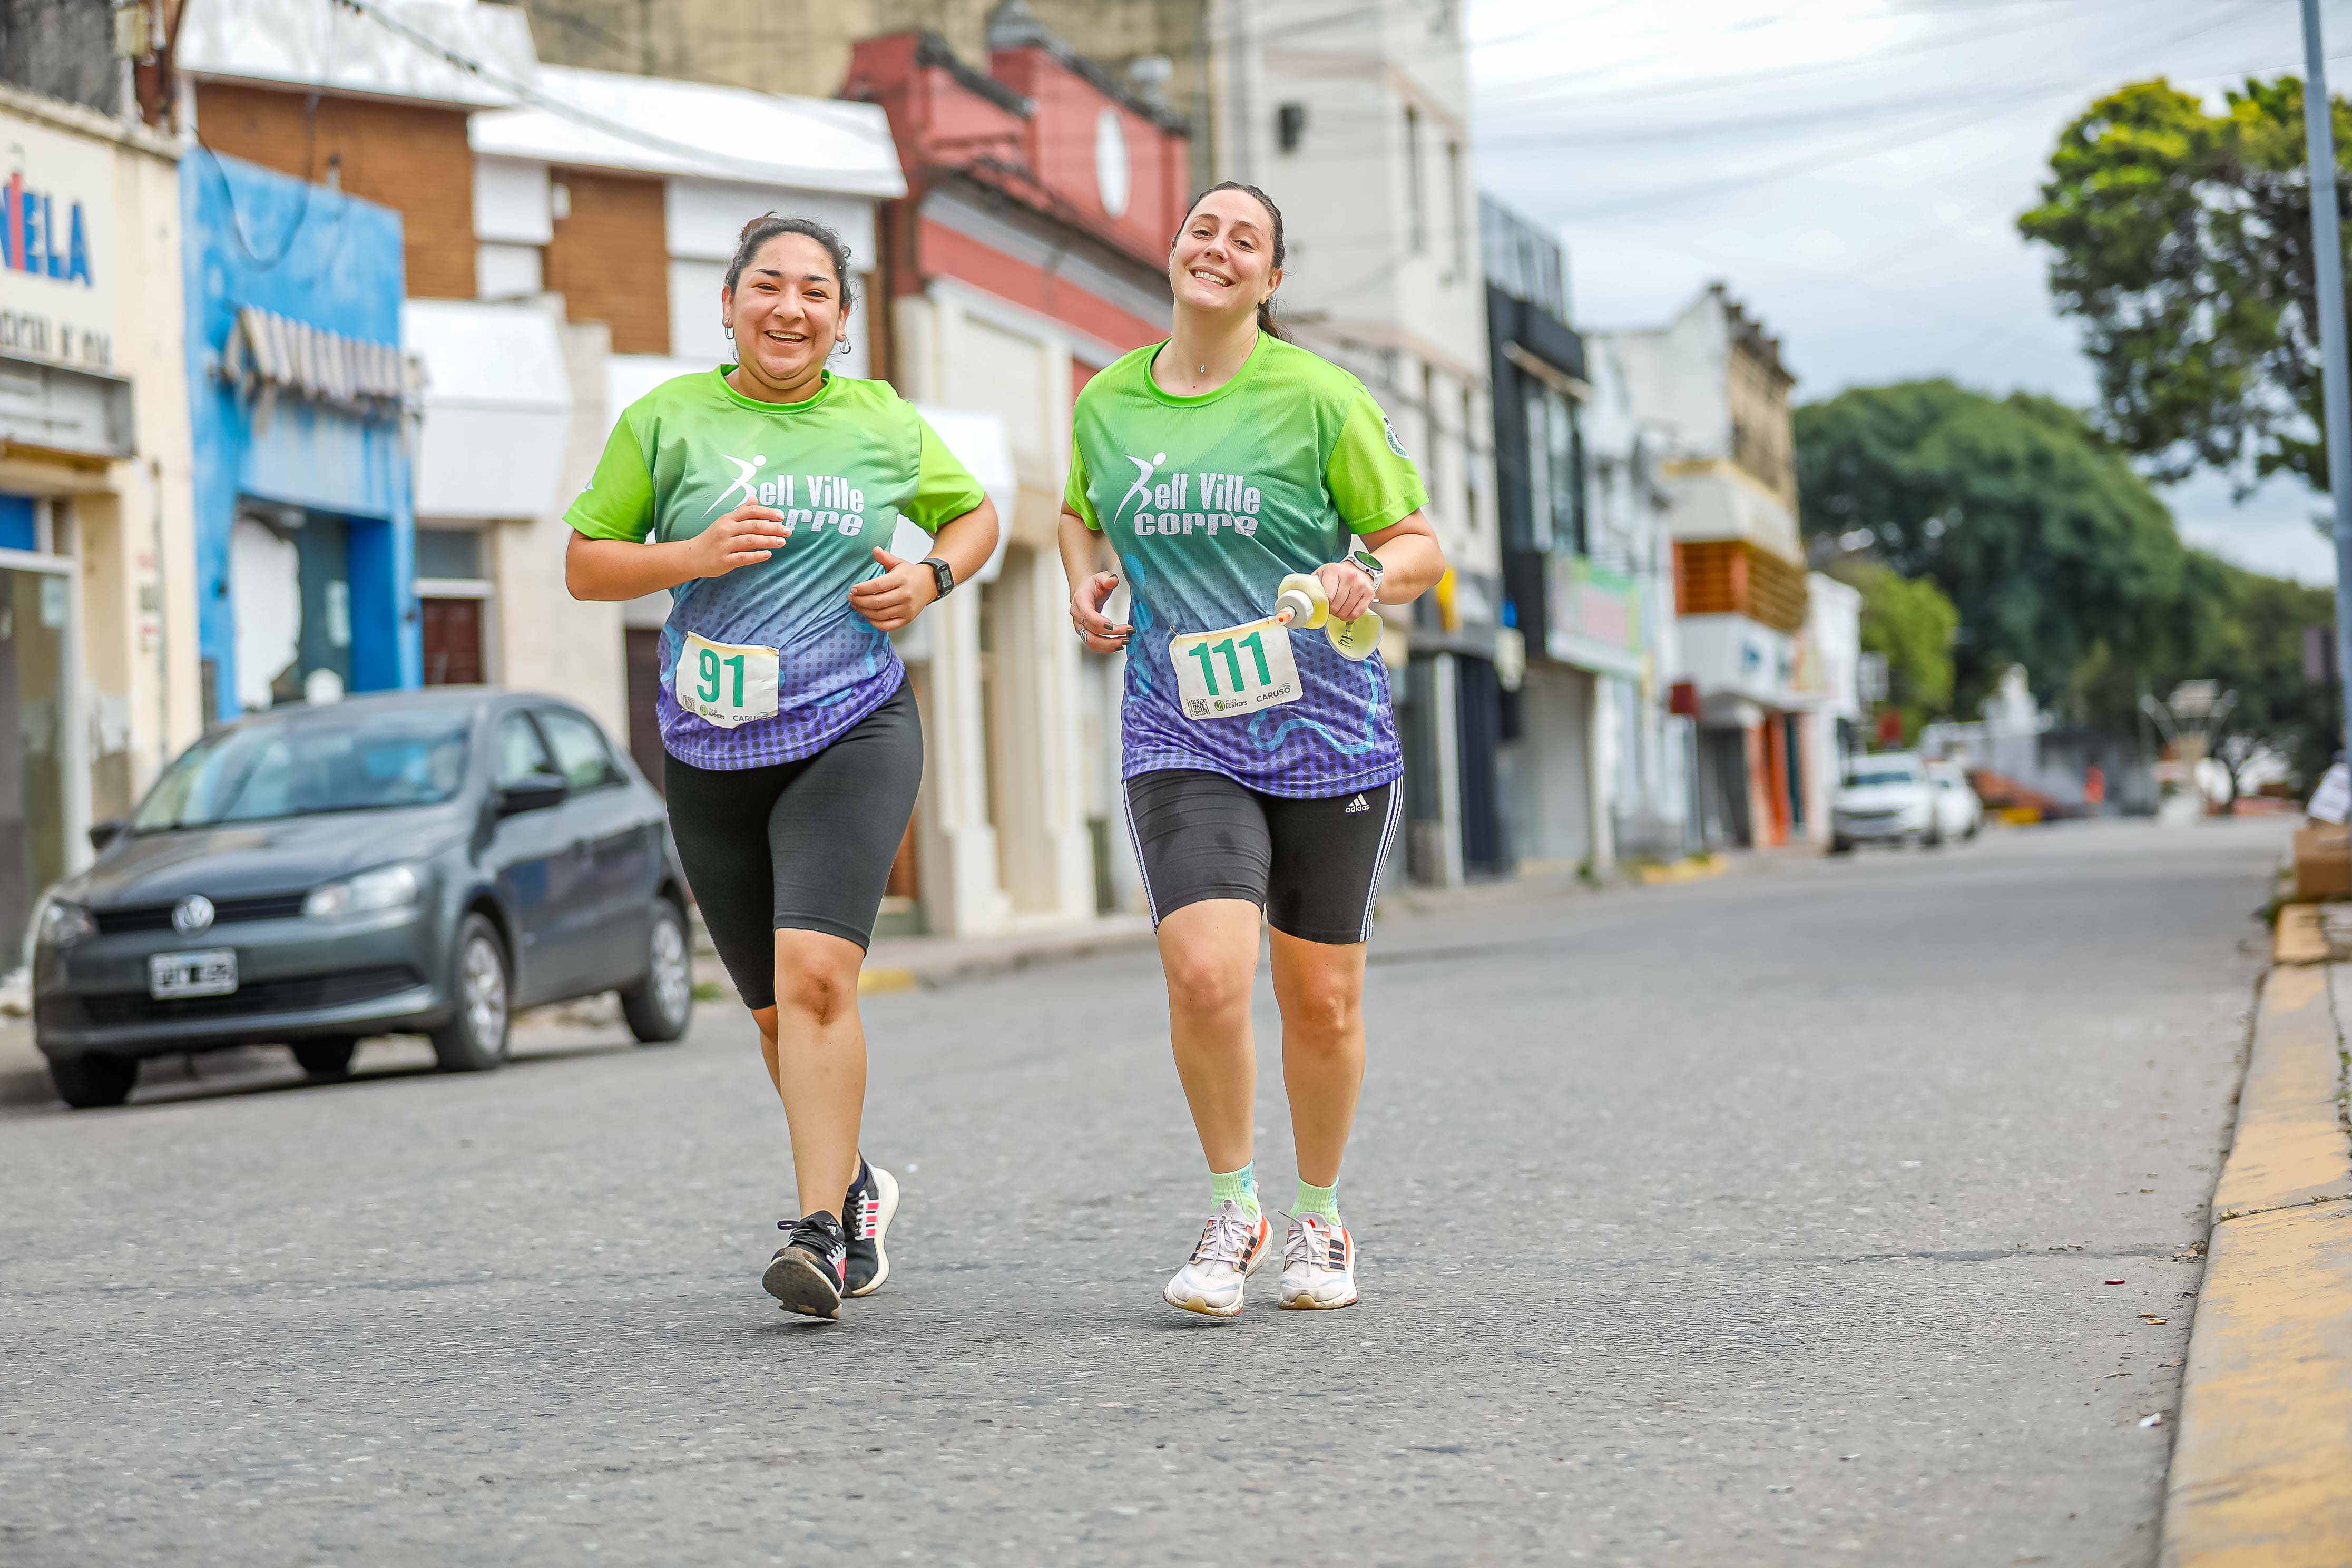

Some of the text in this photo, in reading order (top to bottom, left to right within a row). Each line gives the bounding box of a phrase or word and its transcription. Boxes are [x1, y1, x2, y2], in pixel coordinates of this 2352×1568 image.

[806, 475, 864, 514] Ville
[1200, 473, 1261, 514] Ville
[767, 508, 864, 536] rre
[1134, 513, 1258, 536] corre
[697, 649, 744, 708] 91
[1188, 631, 1272, 696] 111
[1256, 687, 1291, 702] CARUSO
[1345, 804, 1370, 813] adidas
